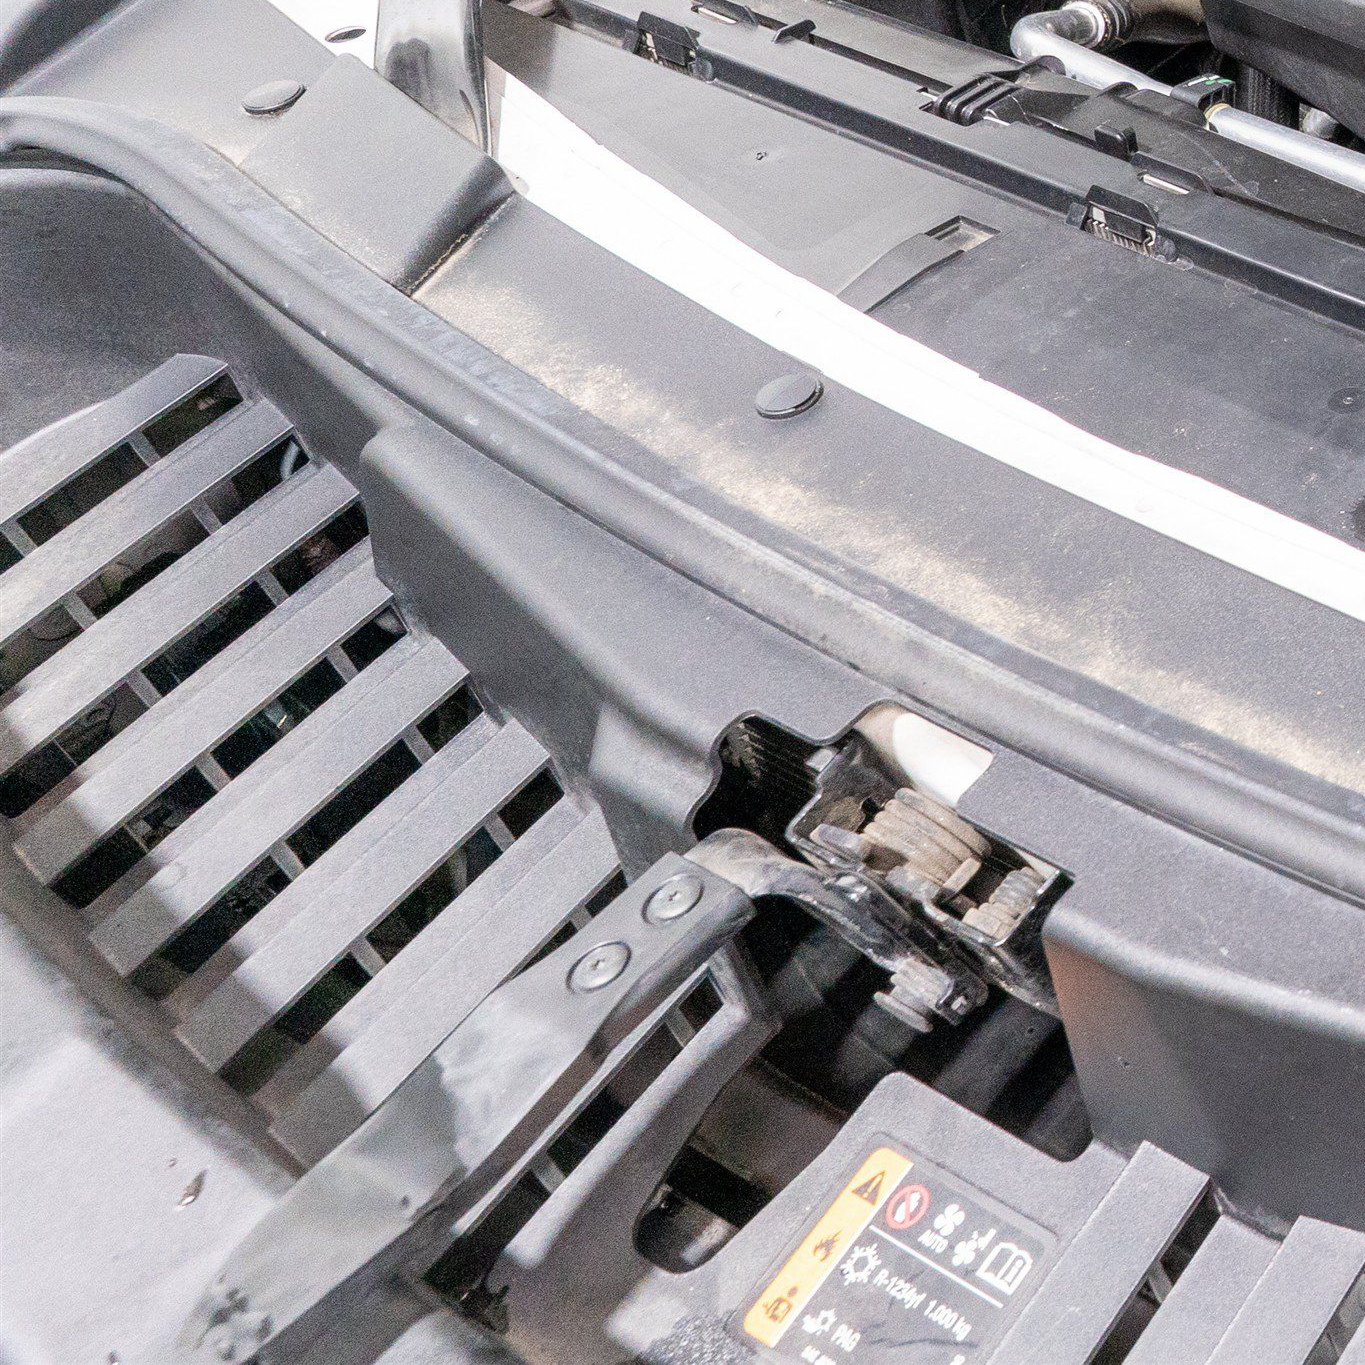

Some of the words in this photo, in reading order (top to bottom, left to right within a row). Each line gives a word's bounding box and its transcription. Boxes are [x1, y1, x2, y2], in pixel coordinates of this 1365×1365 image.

[917, 1229, 949, 1253] AUTO
[923, 1299, 960, 1329] 1.000
[952, 1317, 973, 1341] kg
[830, 1323, 861, 1352] PAG
